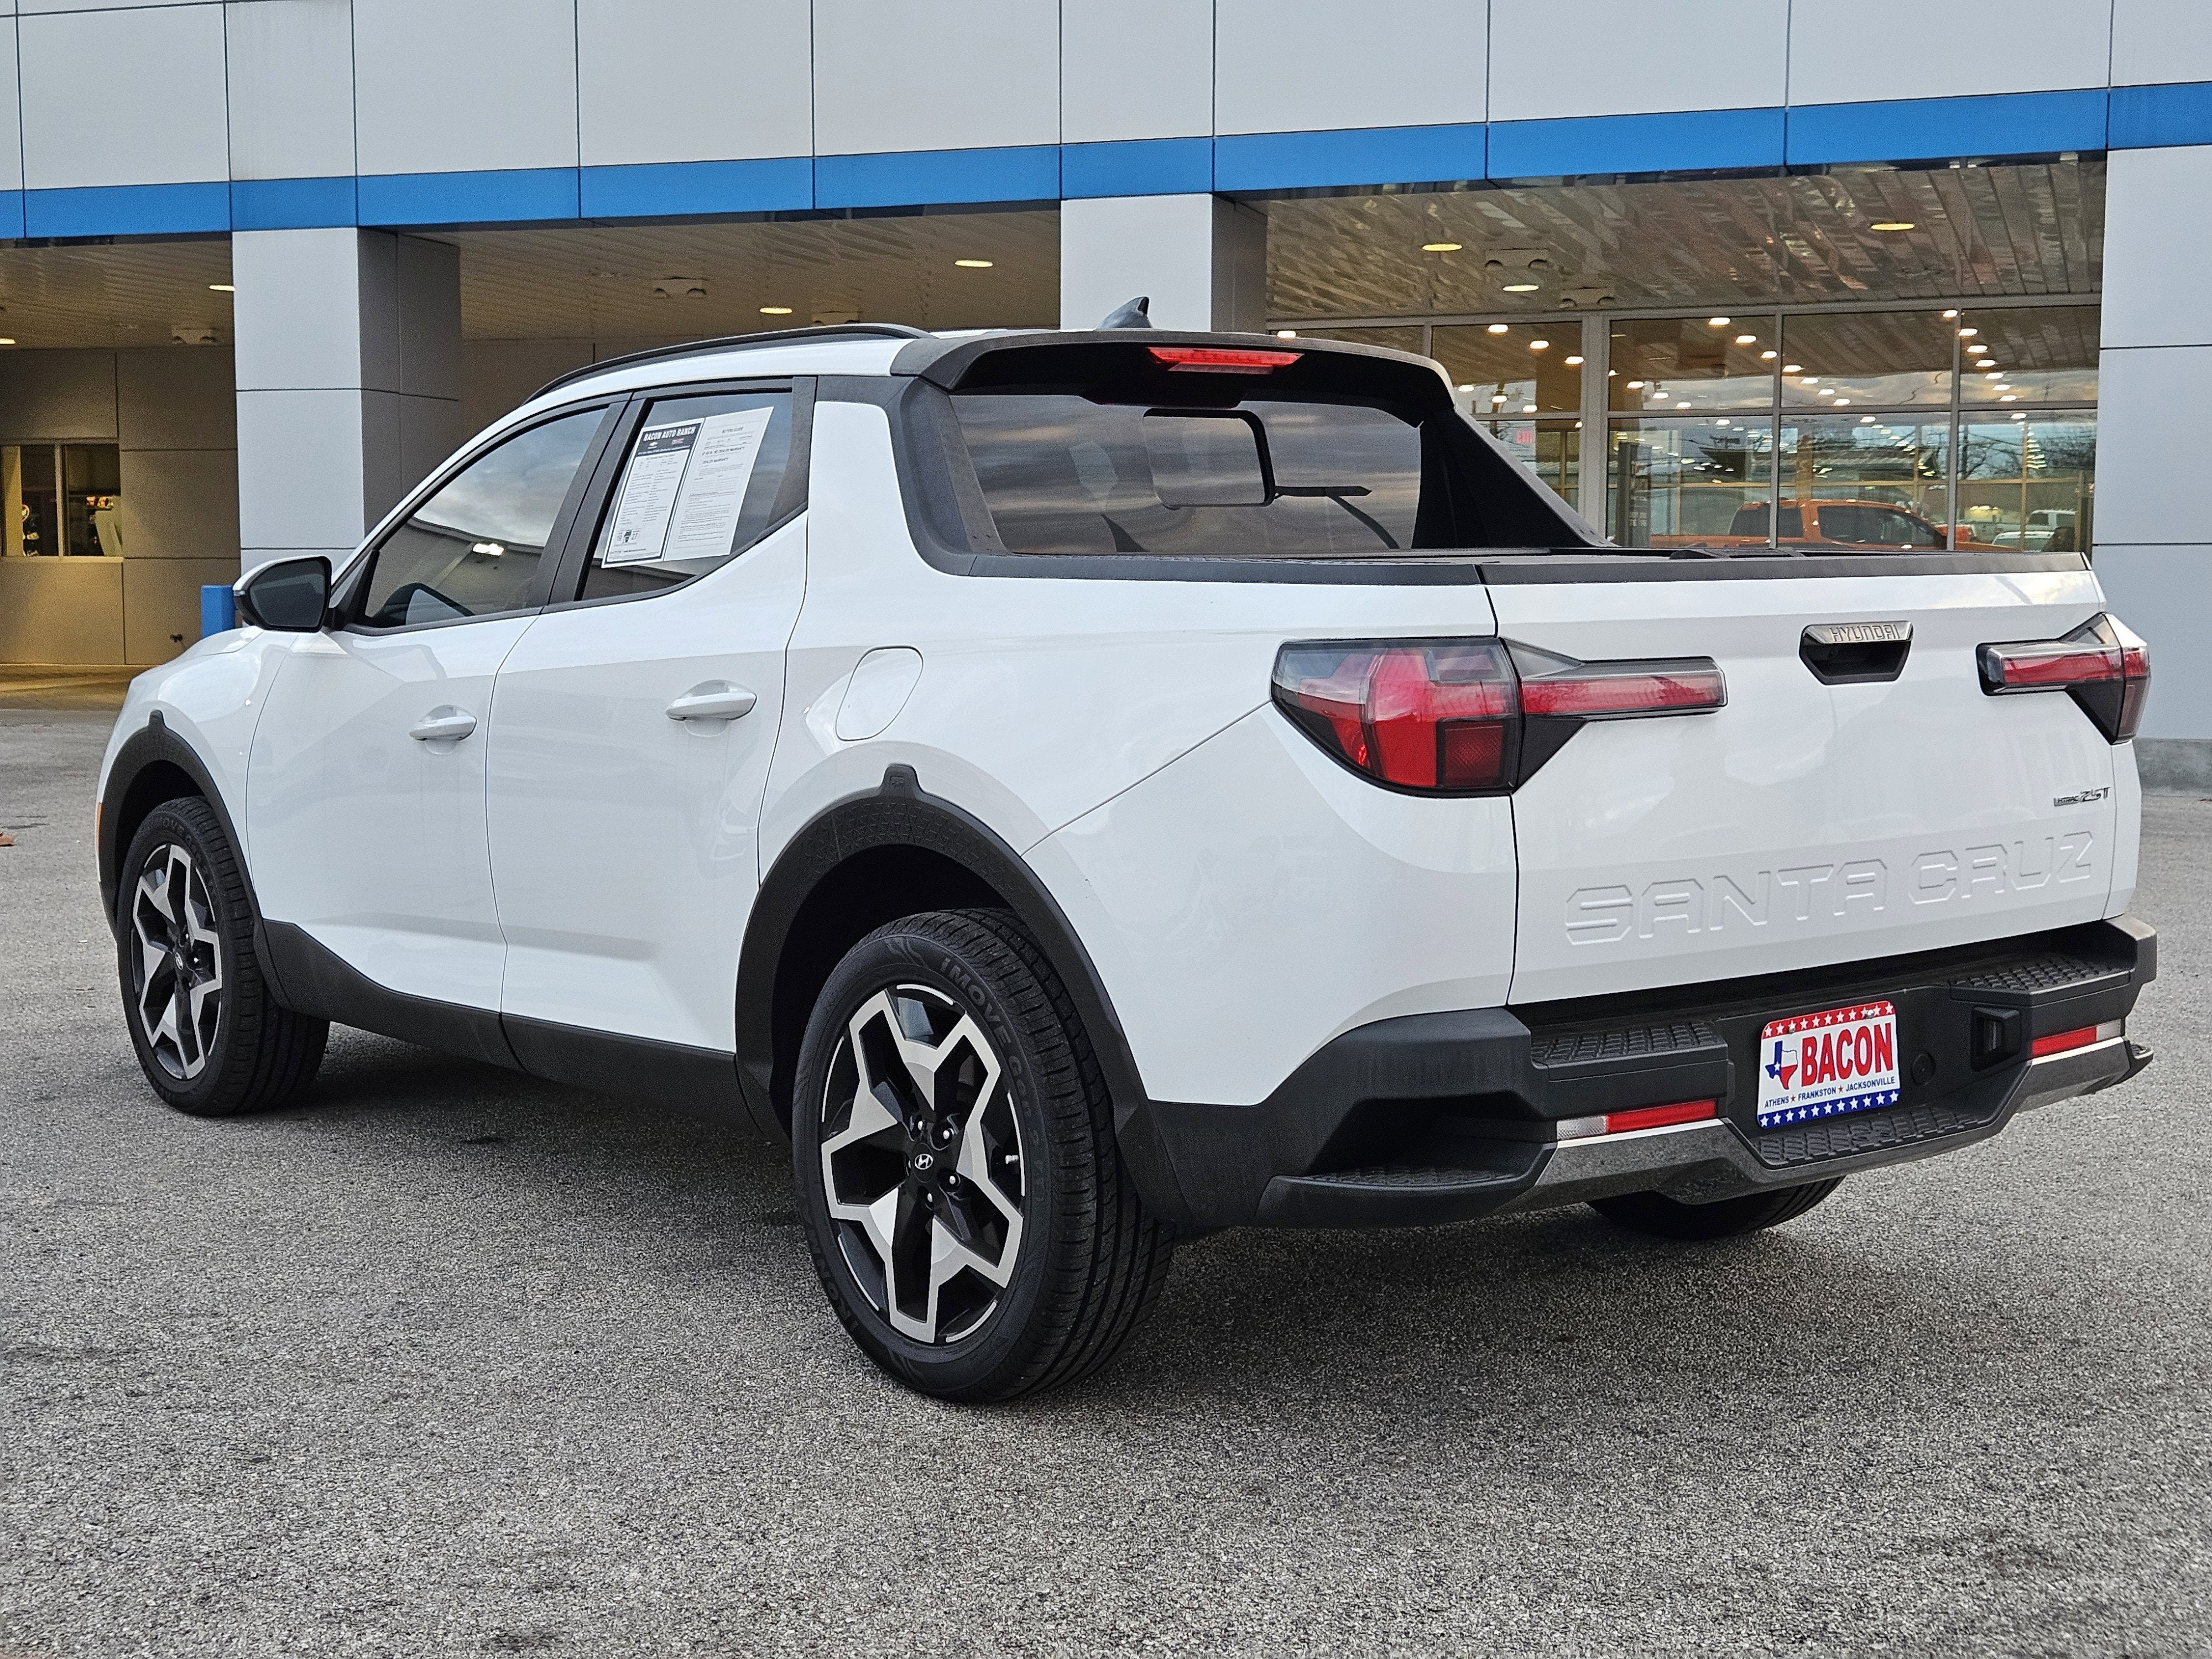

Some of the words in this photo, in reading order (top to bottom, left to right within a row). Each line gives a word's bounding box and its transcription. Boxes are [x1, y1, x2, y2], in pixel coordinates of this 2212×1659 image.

[643, 431, 662, 441] BACON
[661, 429, 676, 439] AUTO
[1829, 624, 1901, 642] HYUNDAI
[1564, 859, 1887, 946] SANTA
[1908, 831, 2093, 905] CRUZ
[1801, 1022, 1893, 1087] BACON
[1764, 1095, 1790, 1109] ATHENS
[1798, 1086, 1837, 1101] FRANKSTON
[1845, 1076, 1895, 1092] JACKSONVILLE
